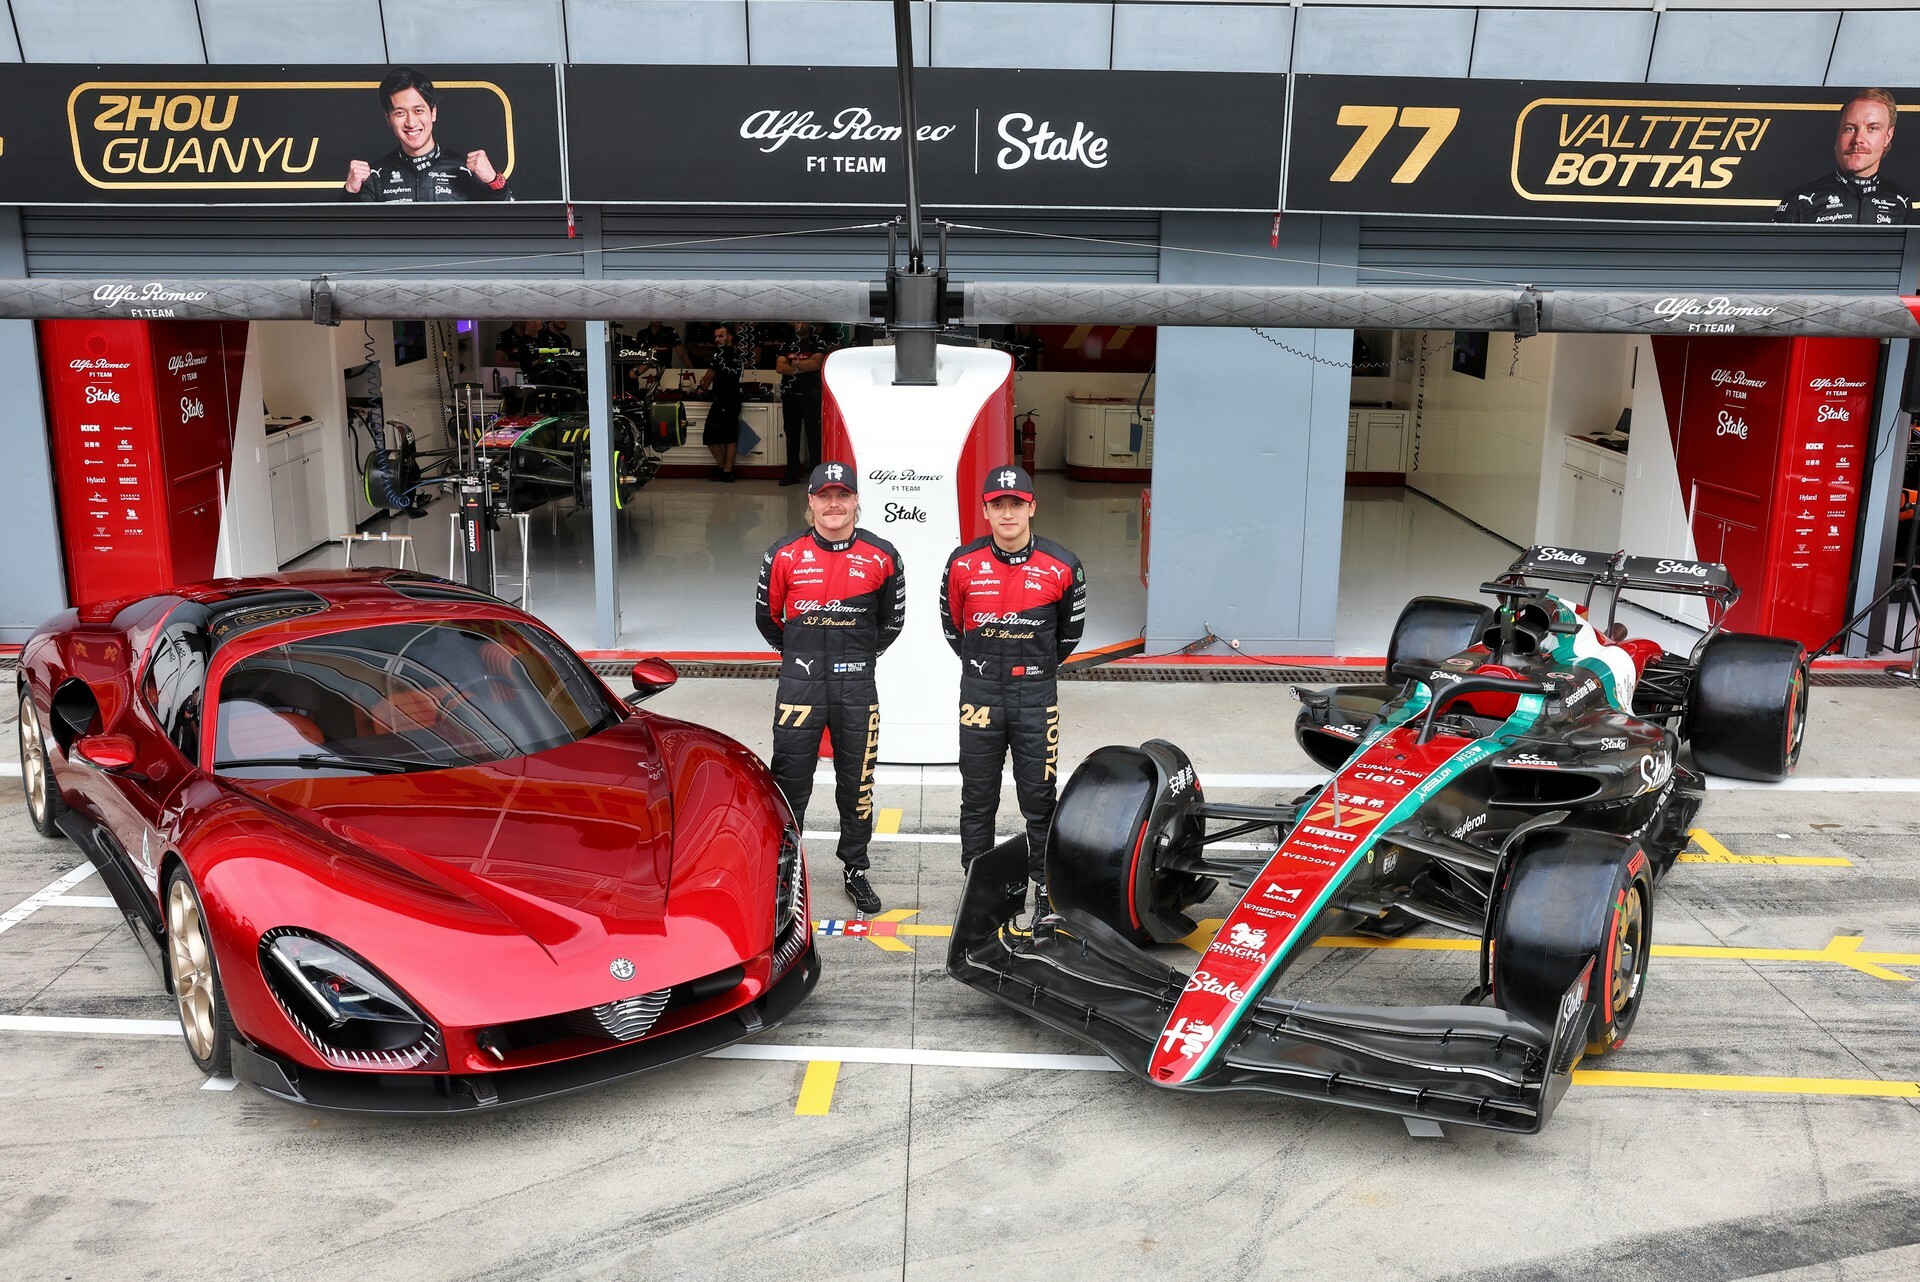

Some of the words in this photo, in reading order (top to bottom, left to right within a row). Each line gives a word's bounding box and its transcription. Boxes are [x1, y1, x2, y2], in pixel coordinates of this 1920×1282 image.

[94, 95, 238, 131] ZHOU
[739, 108, 828, 154] Alfa
[1558, 113, 1770, 151] VALTTERI
[997, 112, 1109, 170] Stake
[1329, 105, 1460, 184] 77
[102, 137, 319, 174] GUANYU
[806, 155, 827, 173] F1
[833, 156, 886, 173] TEAM
[1545, 153, 1741, 189] BOTTAS
[93, 283, 142, 307] Alfa
[138, 283, 207, 302] Romeo
[131, 309, 143, 317] F1
[145, 309, 175, 318] TEAM
[1654, 298, 1706, 321] Alfa
[1702, 297, 1778, 318] Romeo
[1689, 323, 1701, 332] F1
[1703, 324, 1735, 333] TEAM
[619, 349, 648, 358] Stake
[70, 359, 93, 372] Alfa
[92, 359, 131, 369] Romeo
[168, 354, 185, 375] Alfa
[183, 352, 207, 367] Romeo
[187, 372, 198, 380] TEAM
[1711, 368, 1733, 388] Alfa
[1732, 370, 1767, 388] Romeo
[1810, 378, 1832, 391] Alfa
[1830, 377, 1867, 388] Romeo
[85, 386, 120, 404] Stake
[1732, 391, 1747, 400] TEAM
[180, 397, 204, 424] Stake
[1817, 404, 1850, 422] Stake
[80, 424, 100, 432] KICK
[1716, 410, 1748, 440] Stake
[1805, 442, 1824, 450] KICK
[869, 470, 900, 485] Alfa
[899, 469, 945, 481] Romeo
[1799, 494, 1818, 502] Hyland
[884, 502, 927, 523] Stake
[468, 520, 476, 552] CAMOZZI
[1537, 547, 1587, 565] Stake
[1655, 560, 1708, 577] Stake
[794, 600, 823, 614] Alfa
[822, 599, 868, 613] Romeo
[973, 612, 1001, 627] Alfa
[1000, 612, 1046, 626] Romeo
[1430, 670, 1463, 684] Stake
[778, 703, 812, 727] 77
[960, 704, 990, 728] 24
[1044, 705, 1059, 780] ZHOU
[1601, 738, 1628, 750] Stake
[1357, 763, 1393, 772] CURAM
[1394, 768, 1424, 779] DOMI
[1507, 758, 1558, 766] CAMOZZI
[1168, 764, 1194, 798] 安慕希
[1354, 771, 1405, 786] cielo
[1332, 792, 1385, 809] 安慕希
[1305, 801, 1386, 828] 77
[1302, 825, 1357, 842] PIRELLI
[1281, 852, 1337, 867] EVERDOME
[1262, 893, 1295, 903] MARELLI
[1210, 942, 1266, 962] SINGHA
[1184, 971, 1245, 1004] Stake
